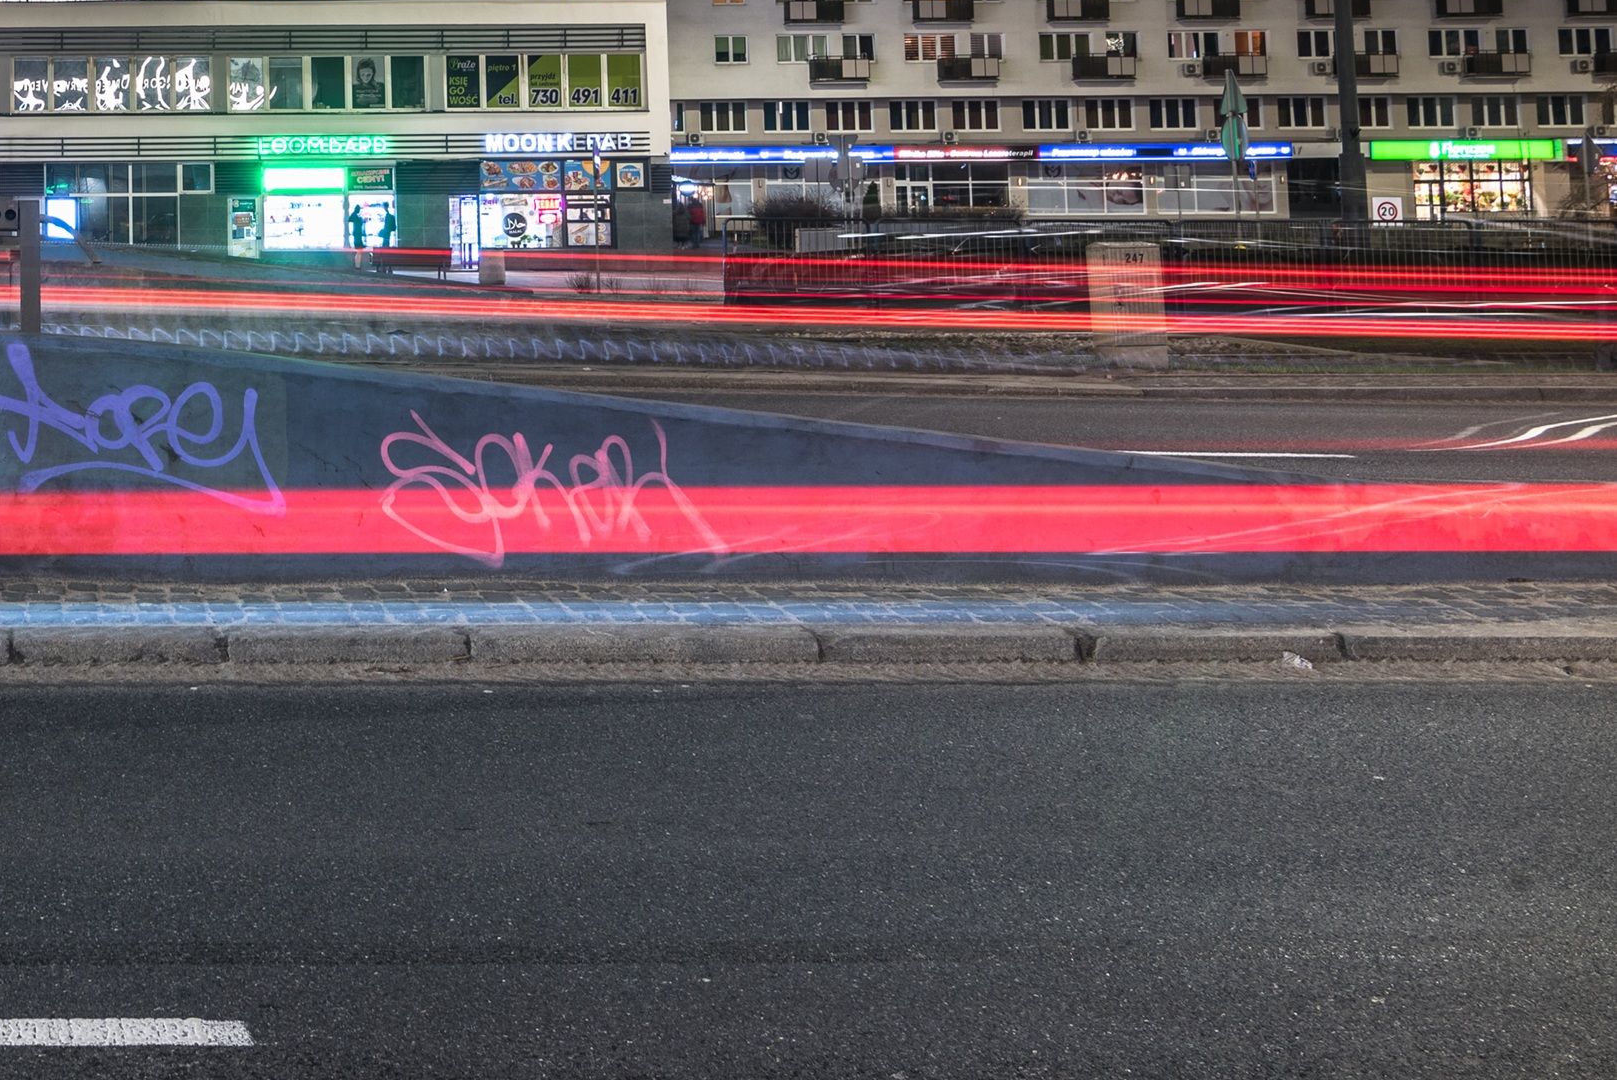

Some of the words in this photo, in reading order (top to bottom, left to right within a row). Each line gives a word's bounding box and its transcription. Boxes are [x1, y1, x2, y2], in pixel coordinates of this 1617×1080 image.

[487, 64, 510, 72] piętro
[512, 63, 517, 71] 1
[449, 76, 468, 87] KSIĘ
[449, 87, 465, 95] GO
[498, 92, 518, 105] tel.
[531, 88, 559, 105] 730
[571, 87, 600, 105] 491
[611, 87, 639, 104] 411
[449, 94, 478, 105] WOŚĆ
[258, 136, 387, 154] LOOMBARD
[485, 134, 554, 152] MOON
[556, 133, 632, 152] KEBAB
[1381, 206, 1395, 216] 20
[1125, 253, 1144, 264] 247
